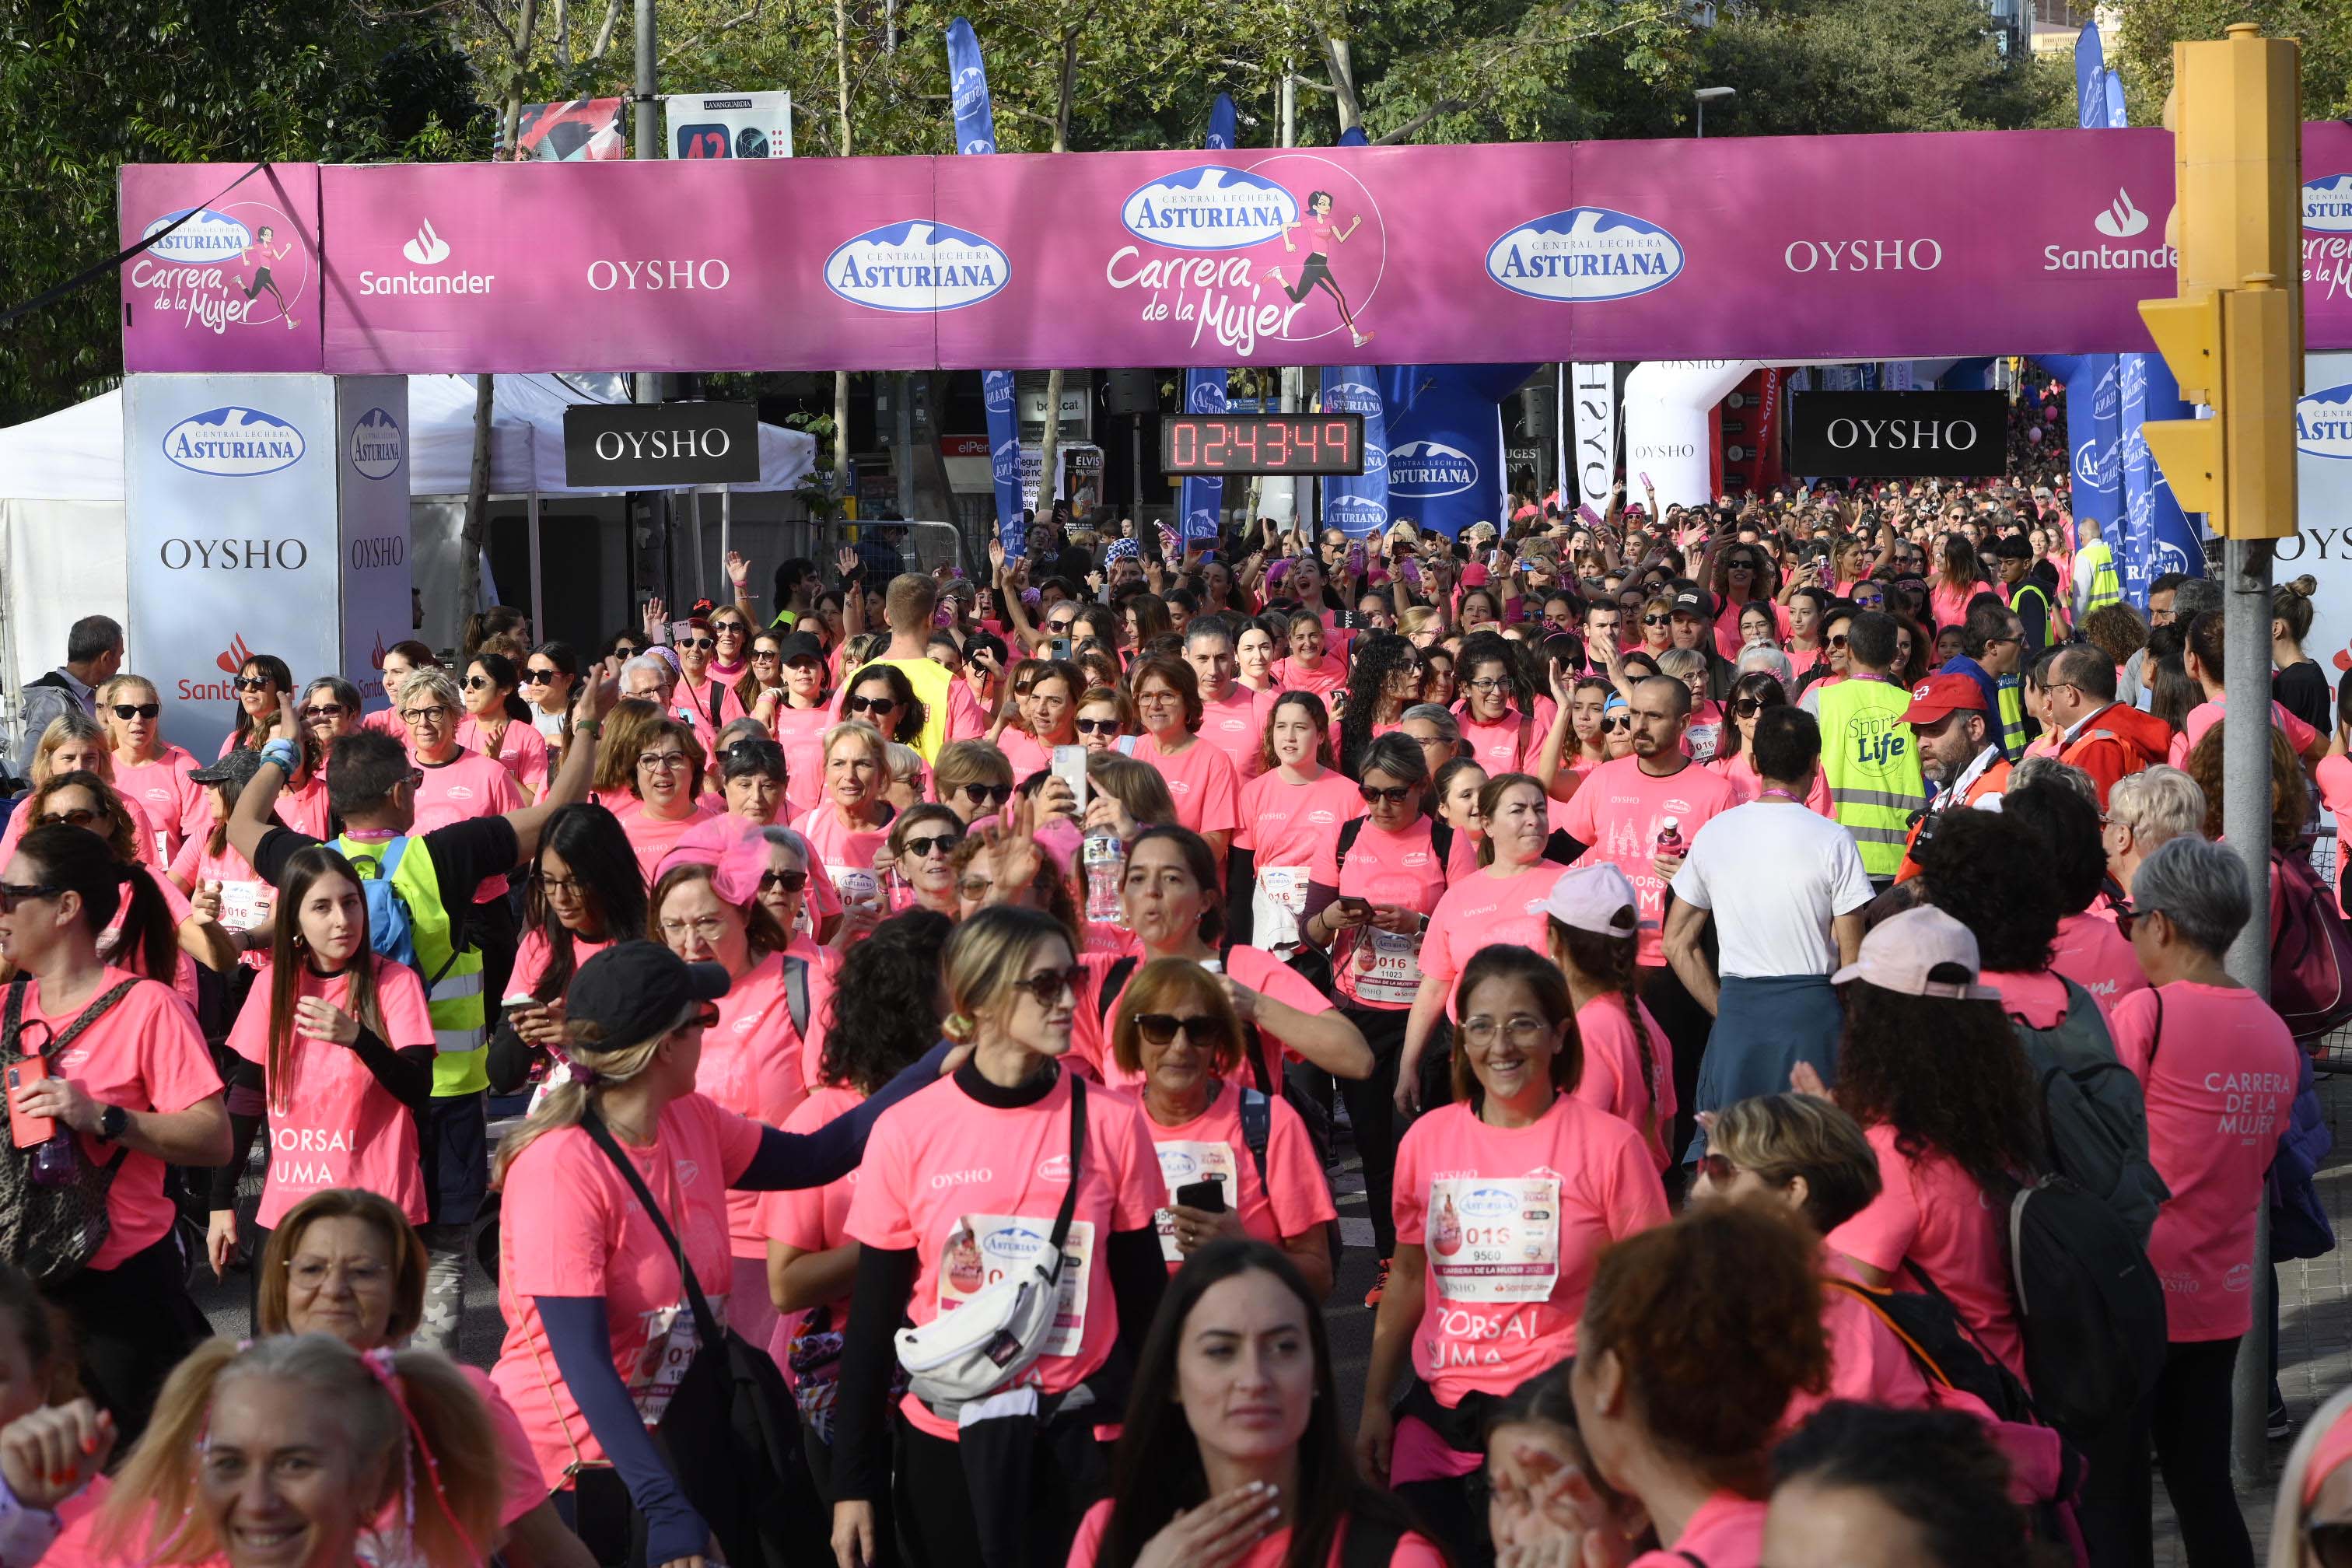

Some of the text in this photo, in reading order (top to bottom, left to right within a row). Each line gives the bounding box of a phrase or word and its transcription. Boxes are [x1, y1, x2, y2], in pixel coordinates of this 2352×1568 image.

[713, 100, 751, 109] VANGUARDIA
[1162, 193, 1280, 204] CENTRAL LECHERA
[1136, 198, 1284, 229] ASTURIANA
[866, 251, 989, 261] CENTRAL LECHERA
[1531, 239, 1662, 250] CENTRAL LECHERA
[1784, 239, 1942, 272] OYSHO
[838, 255, 996, 289] ASTURIANA
[1106, 245, 1252, 289] Carrera
[1501, 243, 1668, 278] ASTURIANA
[2315, 259, 2330, 282] la
[131, 259, 222, 289] Carrera
[360, 271, 495, 296] Santander
[586, 259, 730, 291] OYSHO
[154, 286, 258, 334] de la Mujer
[1142, 283, 1306, 357] de la Mujer
[174, 432, 295, 460] ASTURIANA
[595, 428, 730, 460] OYSHO
[1174, 423, 1348, 466] 02:43:49
[1828, 418, 1977, 450] OYSHO
[355, 434, 399, 462] ASTURIANA
[1076, 456, 1101, 466] ELVIS
[1636, 443, 1694, 460] OYSHO
[160, 538, 307, 570] OYSHO
[352, 535, 403, 570] OYSHO
[1849, 714, 1896, 740] Sport
[1696, 740, 1715, 751] 016
[1857, 733, 1905, 766] Life
[228, 907, 247, 917] 016
[1378, 957, 1406, 969] 016
[1381, 970, 1403, 978] 11023
[2204, 1072, 2290, 1094] CARRERA
[2227, 1093, 2276, 1114] DE LA
[2217, 1114, 2276, 1135] MUJER
[931, 1168, 992, 1189] OYSHO
[1473, 1251, 1501, 1261] 9560
